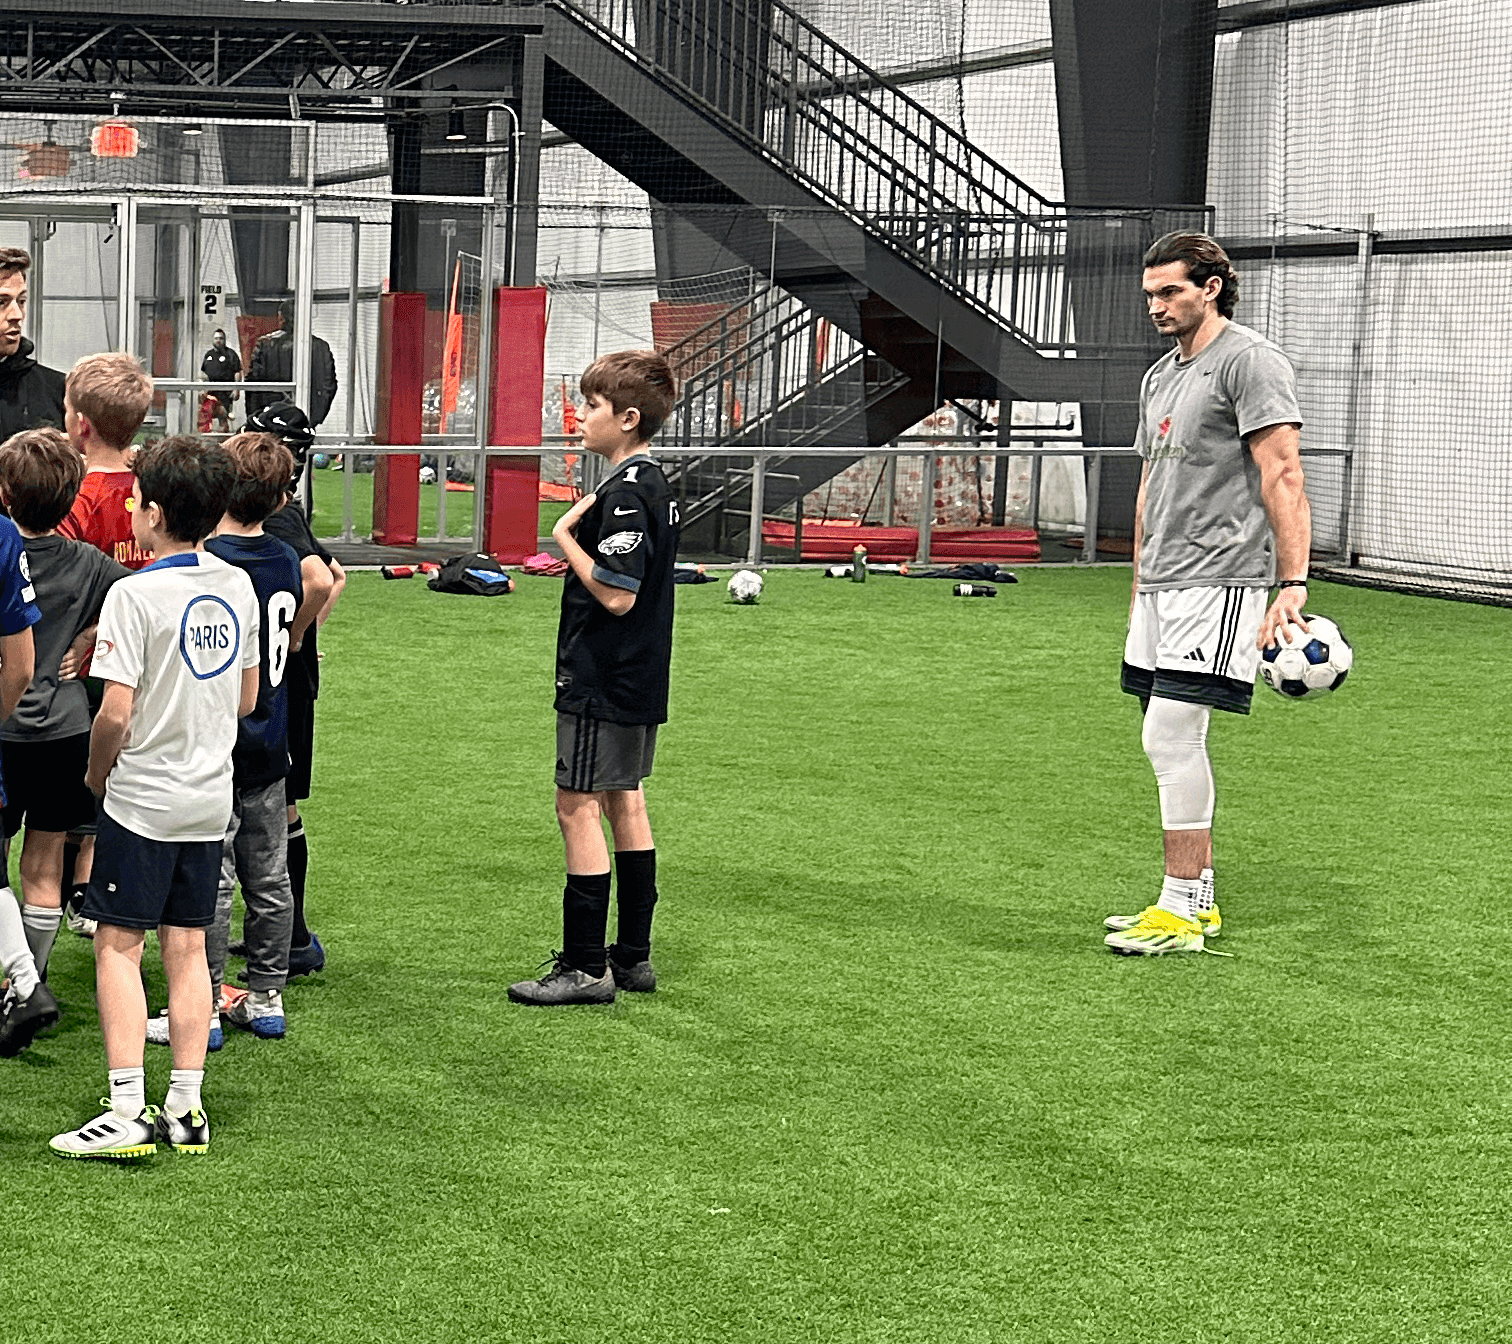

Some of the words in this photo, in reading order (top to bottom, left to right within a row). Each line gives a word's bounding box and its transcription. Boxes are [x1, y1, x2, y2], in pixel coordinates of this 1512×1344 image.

[201, 285, 222, 294] FIELD
[204, 295, 217, 314] 2
[189, 623, 230, 650] PARIS
[267, 590, 296, 687] 6
